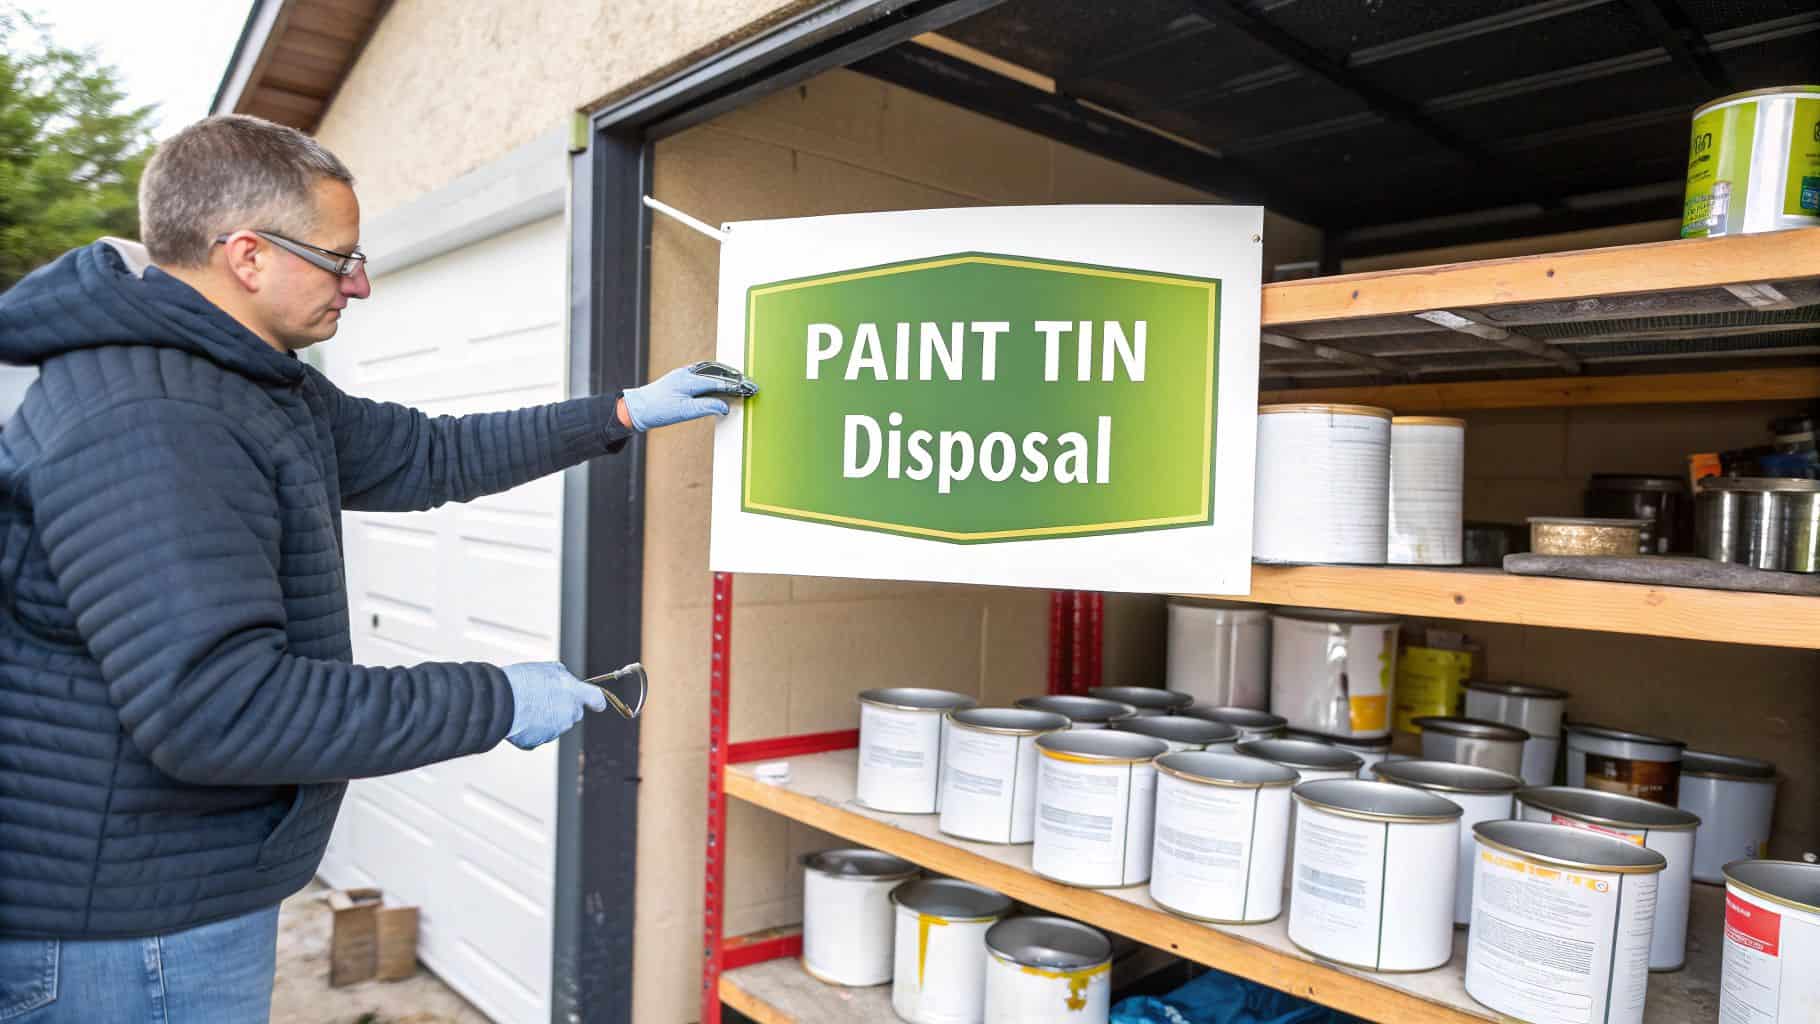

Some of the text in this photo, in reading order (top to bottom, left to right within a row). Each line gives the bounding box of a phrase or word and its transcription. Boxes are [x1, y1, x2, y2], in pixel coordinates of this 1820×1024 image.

[805, 319, 1147, 383] PAINT TIN
[842, 411, 1112, 494] Disposal
